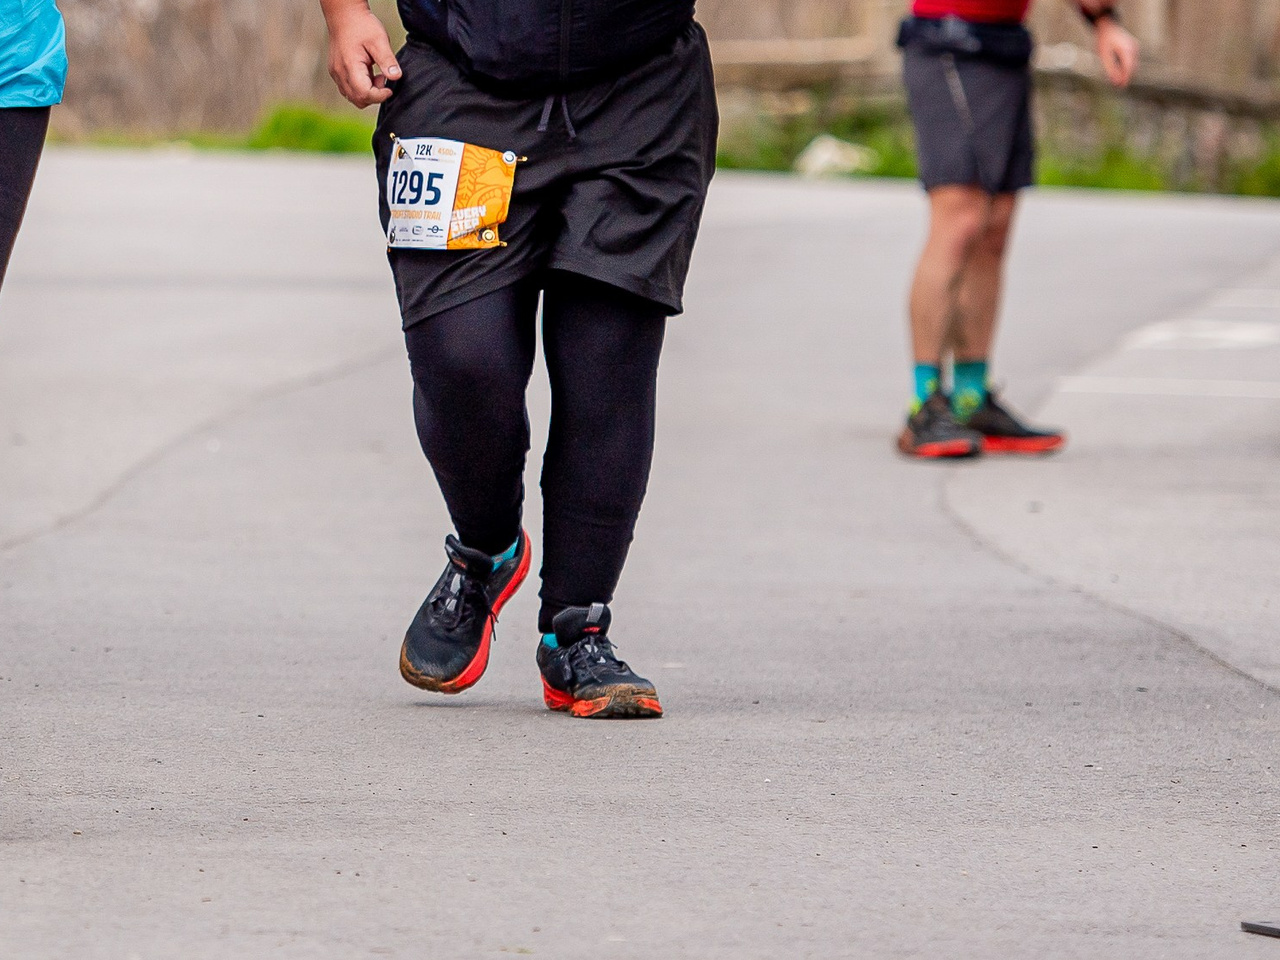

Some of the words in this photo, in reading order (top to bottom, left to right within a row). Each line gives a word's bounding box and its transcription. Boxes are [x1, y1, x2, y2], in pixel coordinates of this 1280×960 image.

[416, 144, 433, 156] 12K
[391, 169, 444, 206] 1295
[423, 210, 442, 221] TRAIL
[451, 205, 486, 222] EVERY
[451, 217, 480, 232] STEP
